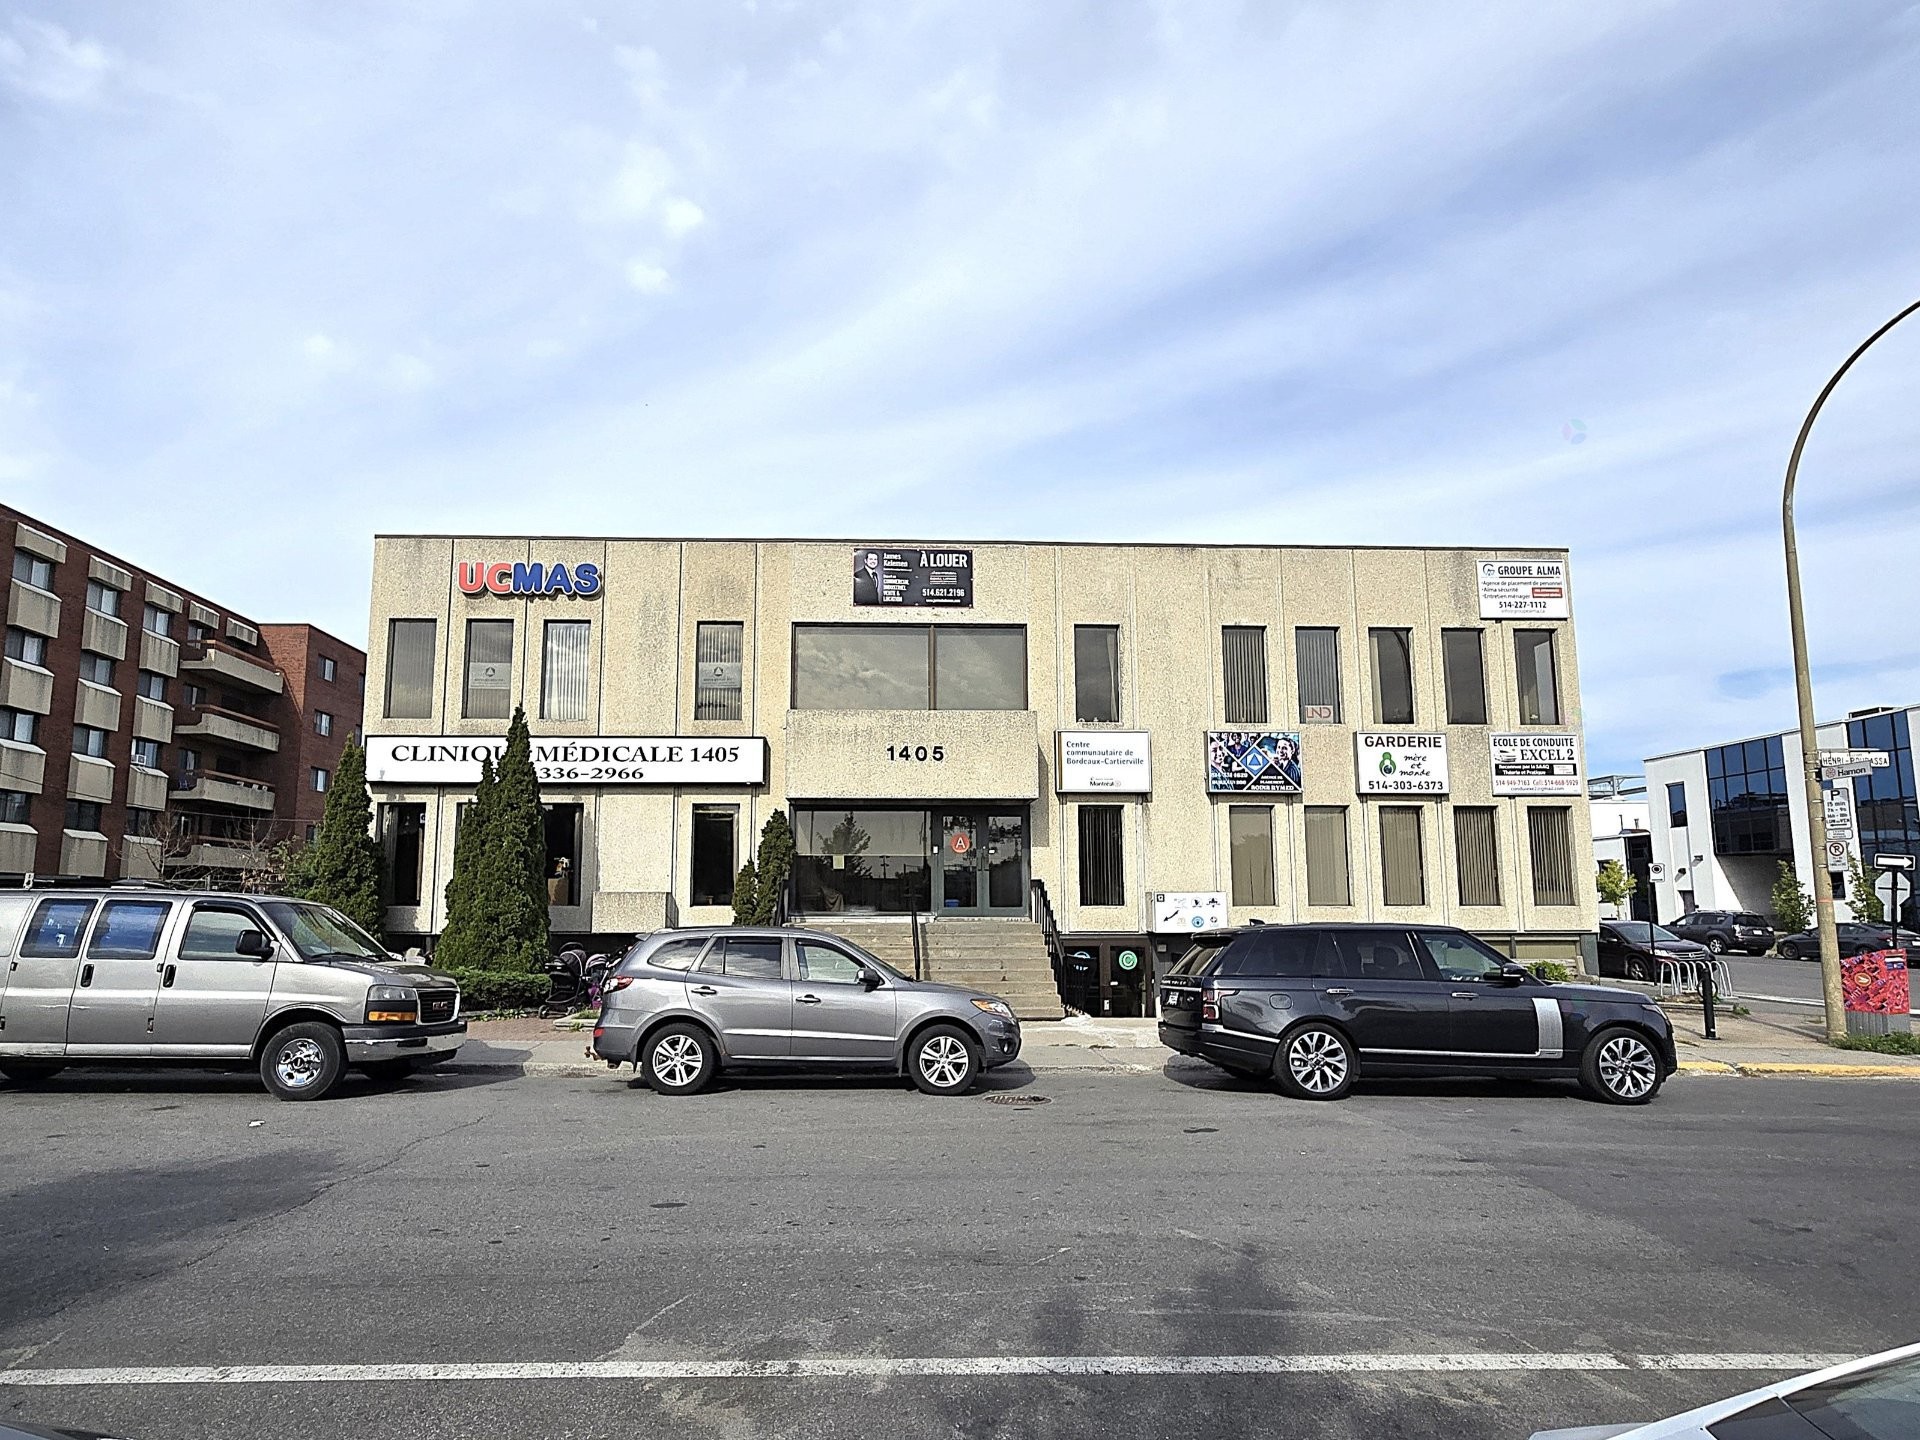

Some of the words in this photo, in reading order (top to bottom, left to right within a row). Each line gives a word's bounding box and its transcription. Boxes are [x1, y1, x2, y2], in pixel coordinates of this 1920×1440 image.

[920, 551, 928, 567] À
[930, 554, 968, 568] LOUER
[1498, 566, 1533, 575] GROUPE
[1537, 566, 1561, 575] ALMA
[458, 562, 600, 595] UCMAS
[922, 589, 965, 597] 514.621.2196
[1364, 736, 1442, 748] GARDERIE
[1493, 737, 1518, 746] ÉCOLE
[1533, 738, 1574, 746] CONDUITE
[535, 742, 684, 762] MÉDICALE
[690, 746, 740, 762] 1405
[887, 746, 944, 761] 1405
[1520, 749, 1565, 761] EXCEL
[1567, 749, 1574, 760] 2
[1837, 768, 1866, 776] Hamon
[1368, 780, 1443, 790] 514-303-6373
[955, 837, 965, 849] A
